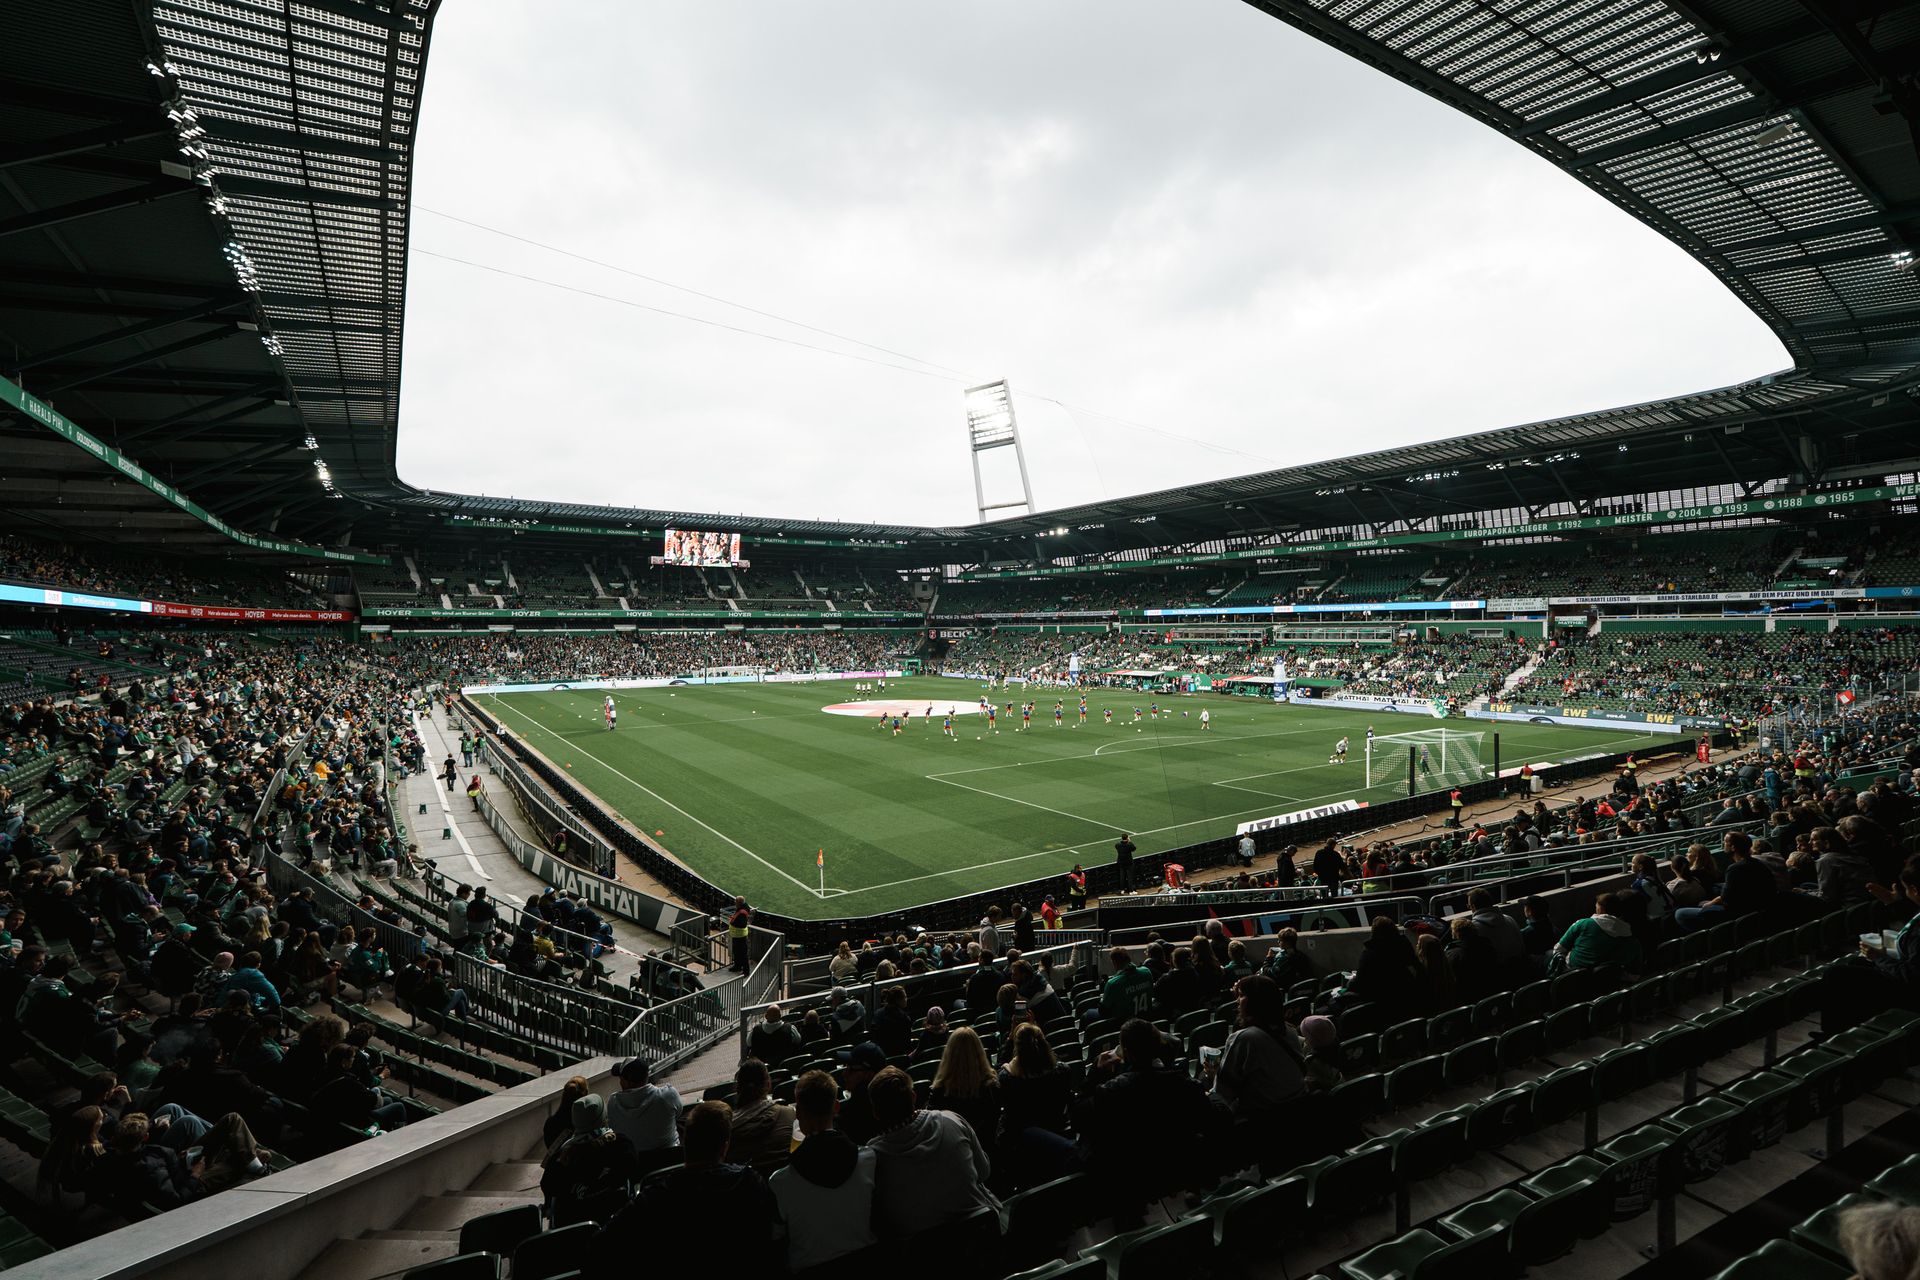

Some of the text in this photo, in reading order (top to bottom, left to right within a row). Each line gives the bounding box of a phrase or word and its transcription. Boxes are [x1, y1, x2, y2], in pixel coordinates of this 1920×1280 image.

[29, 399, 64, 432] HARALD PIHL
[1829, 492, 1855, 503] 1965
[1725, 503, 1748, 513] 1993
[1777, 498, 1803, 508] 1988
[1678, 508, 1701, 518] 2004
[1614, 513, 1653, 525] MEISTER
[1463, 520, 1582, 538] EUROPAPOKAL-SIEGER 1992
[1346, 540, 1379, 548] WIESENHOF
[1238, 549, 1275, 558] WESERSTADION
[245, 611, 265, 619] HOYER
[318, 612, 342, 620] HOYER
[1490, 703, 1512, 713] EWE
[1563, 708, 1588, 718] EWE
[1646, 713, 1674, 724] EWE
[552, 861, 639, 920] MATTHÄI
[1133, 993, 1149, 1015] 14
